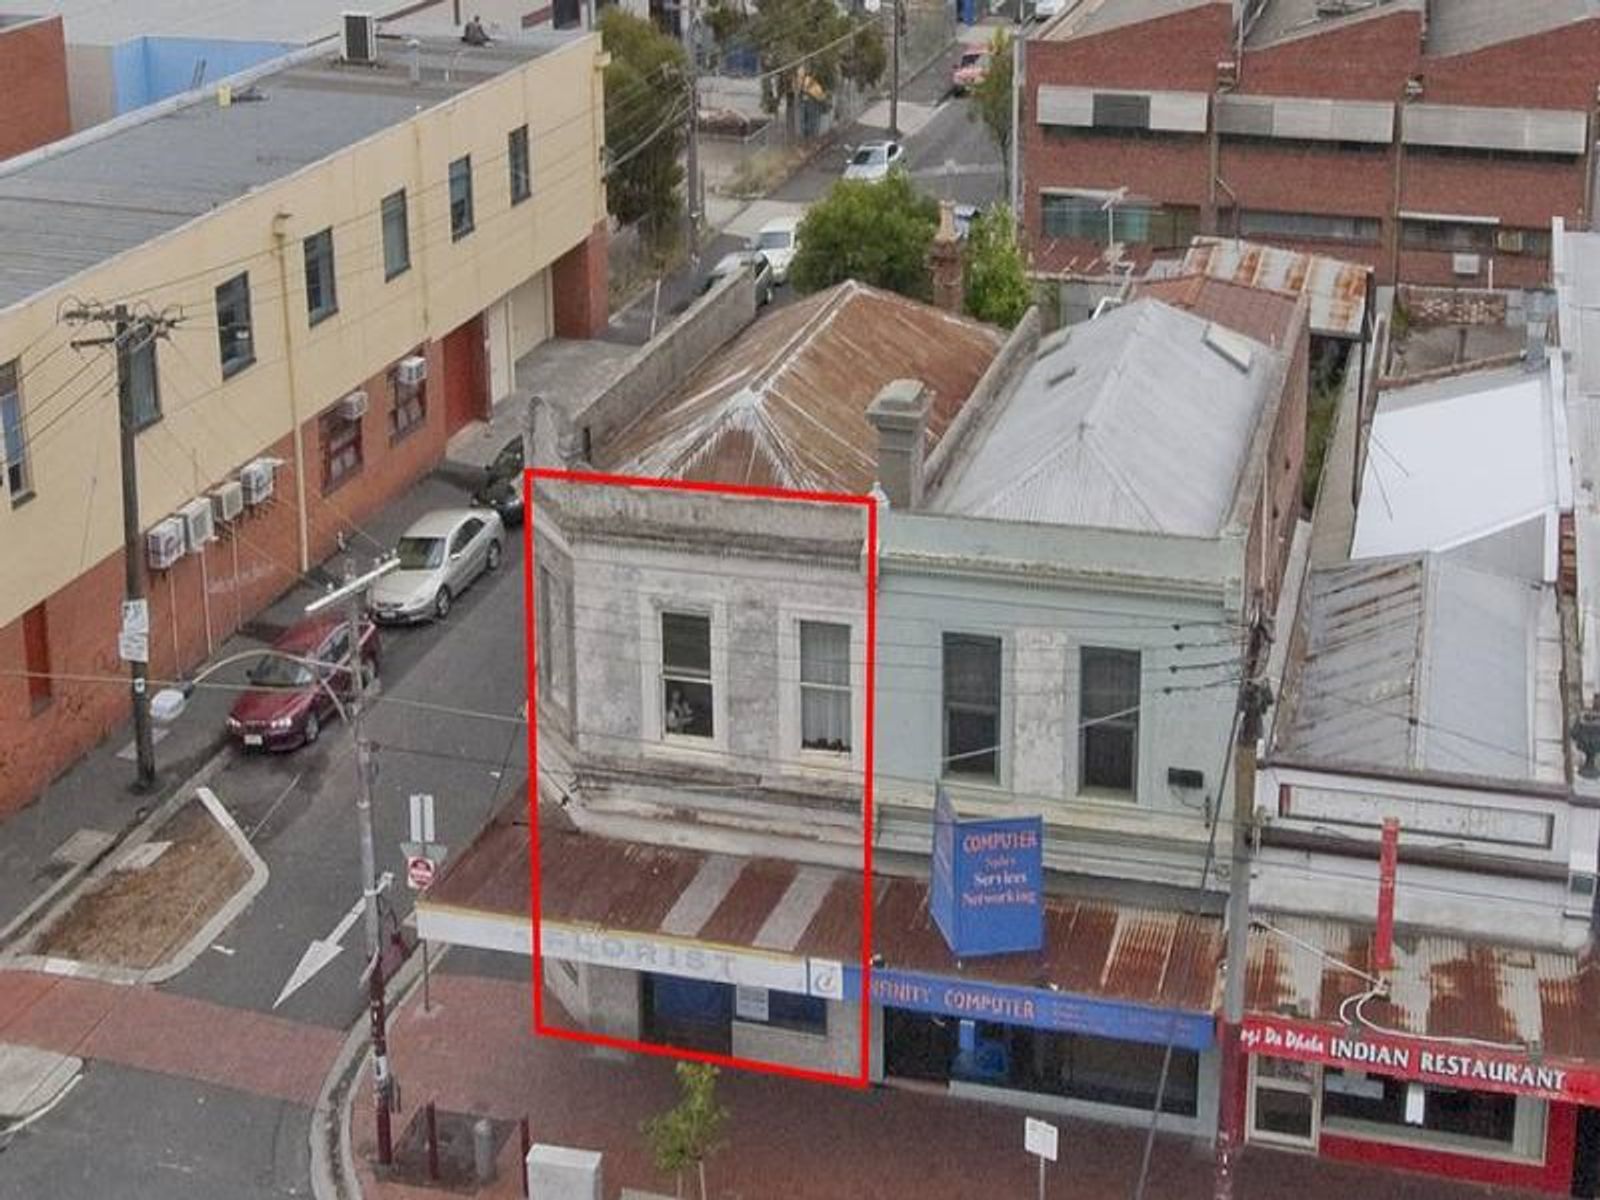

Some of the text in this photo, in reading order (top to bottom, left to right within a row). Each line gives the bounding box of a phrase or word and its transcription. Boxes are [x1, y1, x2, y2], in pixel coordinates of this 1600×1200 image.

[963, 831, 1038, 854] COMPUTER
[972, 870, 1028, 888] Services
[943, 988, 1035, 1020] COMPUTER
[1330, 1037, 1410, 1070] INDIAN
[1419, 1049, 1568, 1091] RESTAURANT
